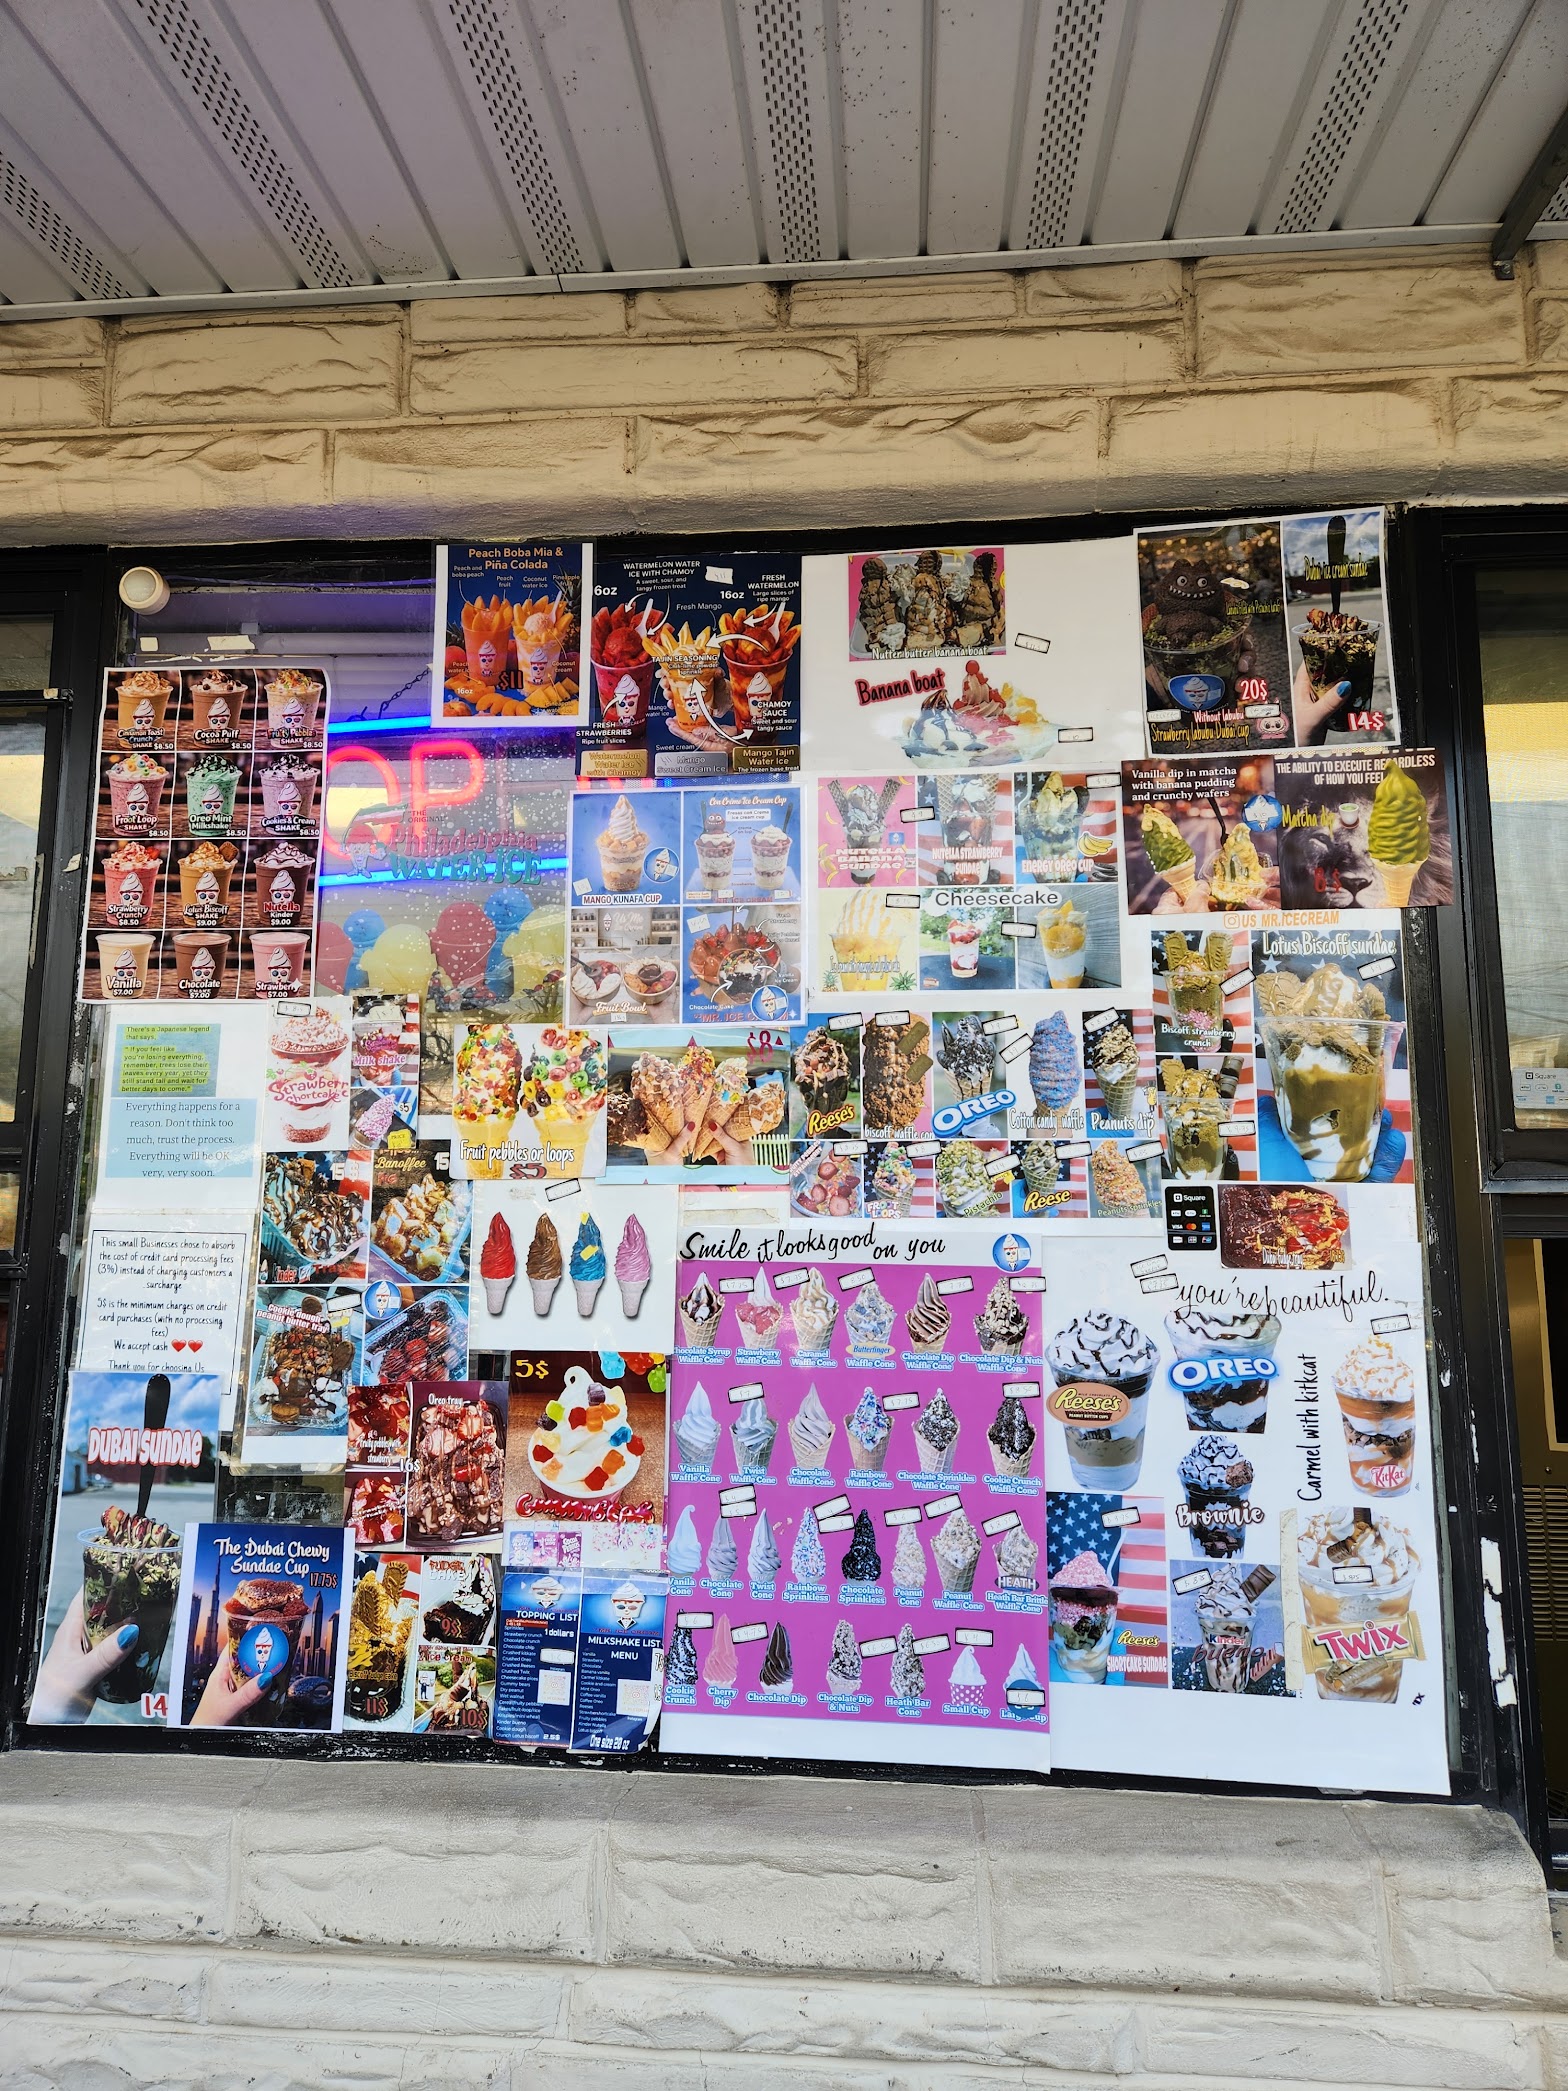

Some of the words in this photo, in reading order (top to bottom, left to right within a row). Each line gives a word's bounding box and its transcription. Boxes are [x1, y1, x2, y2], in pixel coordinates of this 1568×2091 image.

[469, 548, 501, 558] Peach
[504, 548, 531, 558] Boba
[534, 547, 553, 557] Mia
[485, 560, 508, 570] Piña
[511, 559, 548, 570] Colada
[623, 562, 674, 571] WATERMELON
[675, 560, 701, 569] WATER
[628, 570, 640, 578] ICE
[662, 568, 695, 576] CHAMOY
[762, 574, 786, 582] FRESH
[748, 581, 799, 590] WATERMELON
[720, 590, 744, 600] 16oz
[676, 602, 696, 611] Fresh
[698, 602, 722, 612] Mango
[872, 646, 902, 660] Nutter
[905, 646, 932, 658] butter
[499, 671, 524, 690] $11
[857, 681, 911, 704] Banana
[913, 669, 944, 693] boat
[1241, 679, 1268, 701] 20$
[762, 708, 788, 717] SAUCE
[1348, 712, 1384, 730] 14$
[195, 730, 220, 738] Cocoa
[221, 729, 238, 738] Puff
[576, 728, 632, 737] STRAWBERRIES
[1151, 723, 1190, 748] Strawberry
[232, 742, 252, 750] $8.50
[743, 749, 772, 758] Mango
[748, 758, 772, 766] Water
[1276, 762, 1290, 774] THE
[1292, 762, 1320, 774] ABILITY
[1322, 760, 1332, 772] TO
[1334, 760, 1371, 772] EXECUTE
[1132, 768, 1164, 779] Vanilla
[1168, 768, 1182, 780] dip
[1186, 768, 1196, 777] in
[1198, 766, 1236, 776] matcha
[1314, 774, 1324, 786] OF
[1326, 774, 1345, 785] HOW
[1346, 772, 1362, 784] YOU
[1132, 780, 1153, 790] with
[1156, 779, 1191, 790] banana
[1194, 777, 1235, 790] pudding
[1132, 792, 1150, 802] and
[1152, 790, 1193, 804] crunchy
[1196, 788, 1230, 799] wafers
[116, 816, 137, 824] Froot
[139, 816, 156, 825] Loop
[190, 814, 210, 823] Oreo
[212, 814, 232, 822] Mint
[1282, 804, 1317, 828] Matcha
[390, 828, 538, 857] Philadelphia
[388, 849, 490, 882] WATER
[493, 848, 542, 885] ICE
[583, 894, 612, 904] MANGO
[614, 894, 644, 903] KUNAFA
[645, 894, 662, 903] CUP
[934, 891, 1058, 906] Cheesecake
[108, 904, 148, 914] Strawberry
[264, 902, 300, 912] Nutella
[1262, 932, 1300, 955] Lotus
[1302, 932, 1348, 956] Biscoff
[1351, 932, 1397, 955] sundae
[106, 976, 142, 989] Vanilla
[179, 980, 220, 989] Chocolate
[268, 990, 288, 998] $7.00
[596, 1002, 620, 1012] Fruit
[620, 1002, 648, 1012] Bowl
[746, 1031, 773, 1064] $8
[1184, 1038, 1212, 1048] crunch
[354, 1056, 376, 1066] Milk
[378, 1054, 406, 1065] shake
[126, 1102, 177, 1113] Everything
[178, 1102, 216, 1113] happens
[219, 1102, 233, 1111] for
[934, 1090, 1014, 1132] OREO
[166, 1118, 190, 1128] Don't
[192, 1118, 216, 1128] think
[218, 1119, 234, 1128] too
[1010, 1108, 1036, 1130] Cotton
[1037, 1109, 1060, 1137] candy
[1061, 1109, 1084, 1130] waffle
[1090, 1112, 1135, 1132] Peanuts
[126, 1136, 154, 1145] much,
[158, 1136, 178, 1144] trust
[181, 1136, 196, 1144] the
[198, 1137, 234, 1147] process.
[130, 1152, 180, 1162] Everything
[183, 1151, 200, 1160] will
[459, 1140, 486, 1162] Fruit
[488, 1140, 528, 1169] pebbles
[530, 1146, 544, 1162] or
[546, 1141, 574, 1168] loops
[375, 1157, 427, 1170] Banoffee
[964, 1191, 1003, 1217] Pistachio
[1183, 1194, 1206, 1202] Square
[101, 1236, 116, 1248] This
[118, 1238, 138, 1248] small
[140, 1239, 178, 1248] Businesses
[180, 1240, 200, 1249] chose
[212, 1242, 236, 1250] absorb
[680, 1229, 750, 1260] Smile
[757, 1236, 774, 1264] it
[778, 1230, 826, 1256] looks
[828, 1221, 875, 1260] good
[872, 1241, 898, 1260] on
[904, 1236, 946, 1262] you
[120, 1266, 144, 1275] instead
[1176, 1276, 1263, 1320] you're
[1264, 1270, 1390, 1323] beautiful.
[97, 1298, 106, 1308] 5$
[130, 1300, 164, 1310] minimum
[114, 1340, 126, 1350] We
[152, 1340, 168, 1351] cash
[852, 1344, 892, 1356] Butterfinger
[737, 1349, 780, 1359] Strawberry
[515, 1359, 549, 1380] 5$
[1171, 1357, 1277, 1388] OREO
[428, 1393, 446, 1406] Oreo
[1298, 1411, 1320, 1442] with
[88, 1428, 140, 1464] DUBAI
[400, 1458, 421, 1473] 16$
[680, 1464, 710, 1474] Vanilla
[898, 1472, 936, 1482] Chocolate
[938, 1473, 976, 1484] Sprinkles
[1297, 1445, 1322, 1502] Carmel
[1374, 1466, 1405, 1488] KitKat
[1176, 1502, 1265, 1530] Brownie
[212, 1538, 241, 1558] The
[244, 1538, 284, 1558] Dubai
[288, 1542, 330, 1562] Chewy
[230, 1558, 280, 1576] Sundae
[284, 1560, 310, 1578] Cup
[310, 1572, 338, 1589] 17.75$
[998, 1578, 1038, 1592] HEATH
[516, 1610, 556, 1621] TOPPING
[560, 1612, 578, 1622] LIST
[588, 1636, 641, 1648] MILKSHAKE
[644, 1638, 661, 1648] LIST
[610, 1650, 638, 1661] MENU
[708, 1688, 737, 1698] Cherry
[144, 1694, 168, 1718] 14
[746, 1694, 785, 1704] Chocolate
[786, 1695, 807, 1706] Dip
[944, 1705, 970, 1716] Small
[972, 1706, 990, 1718] Cup
